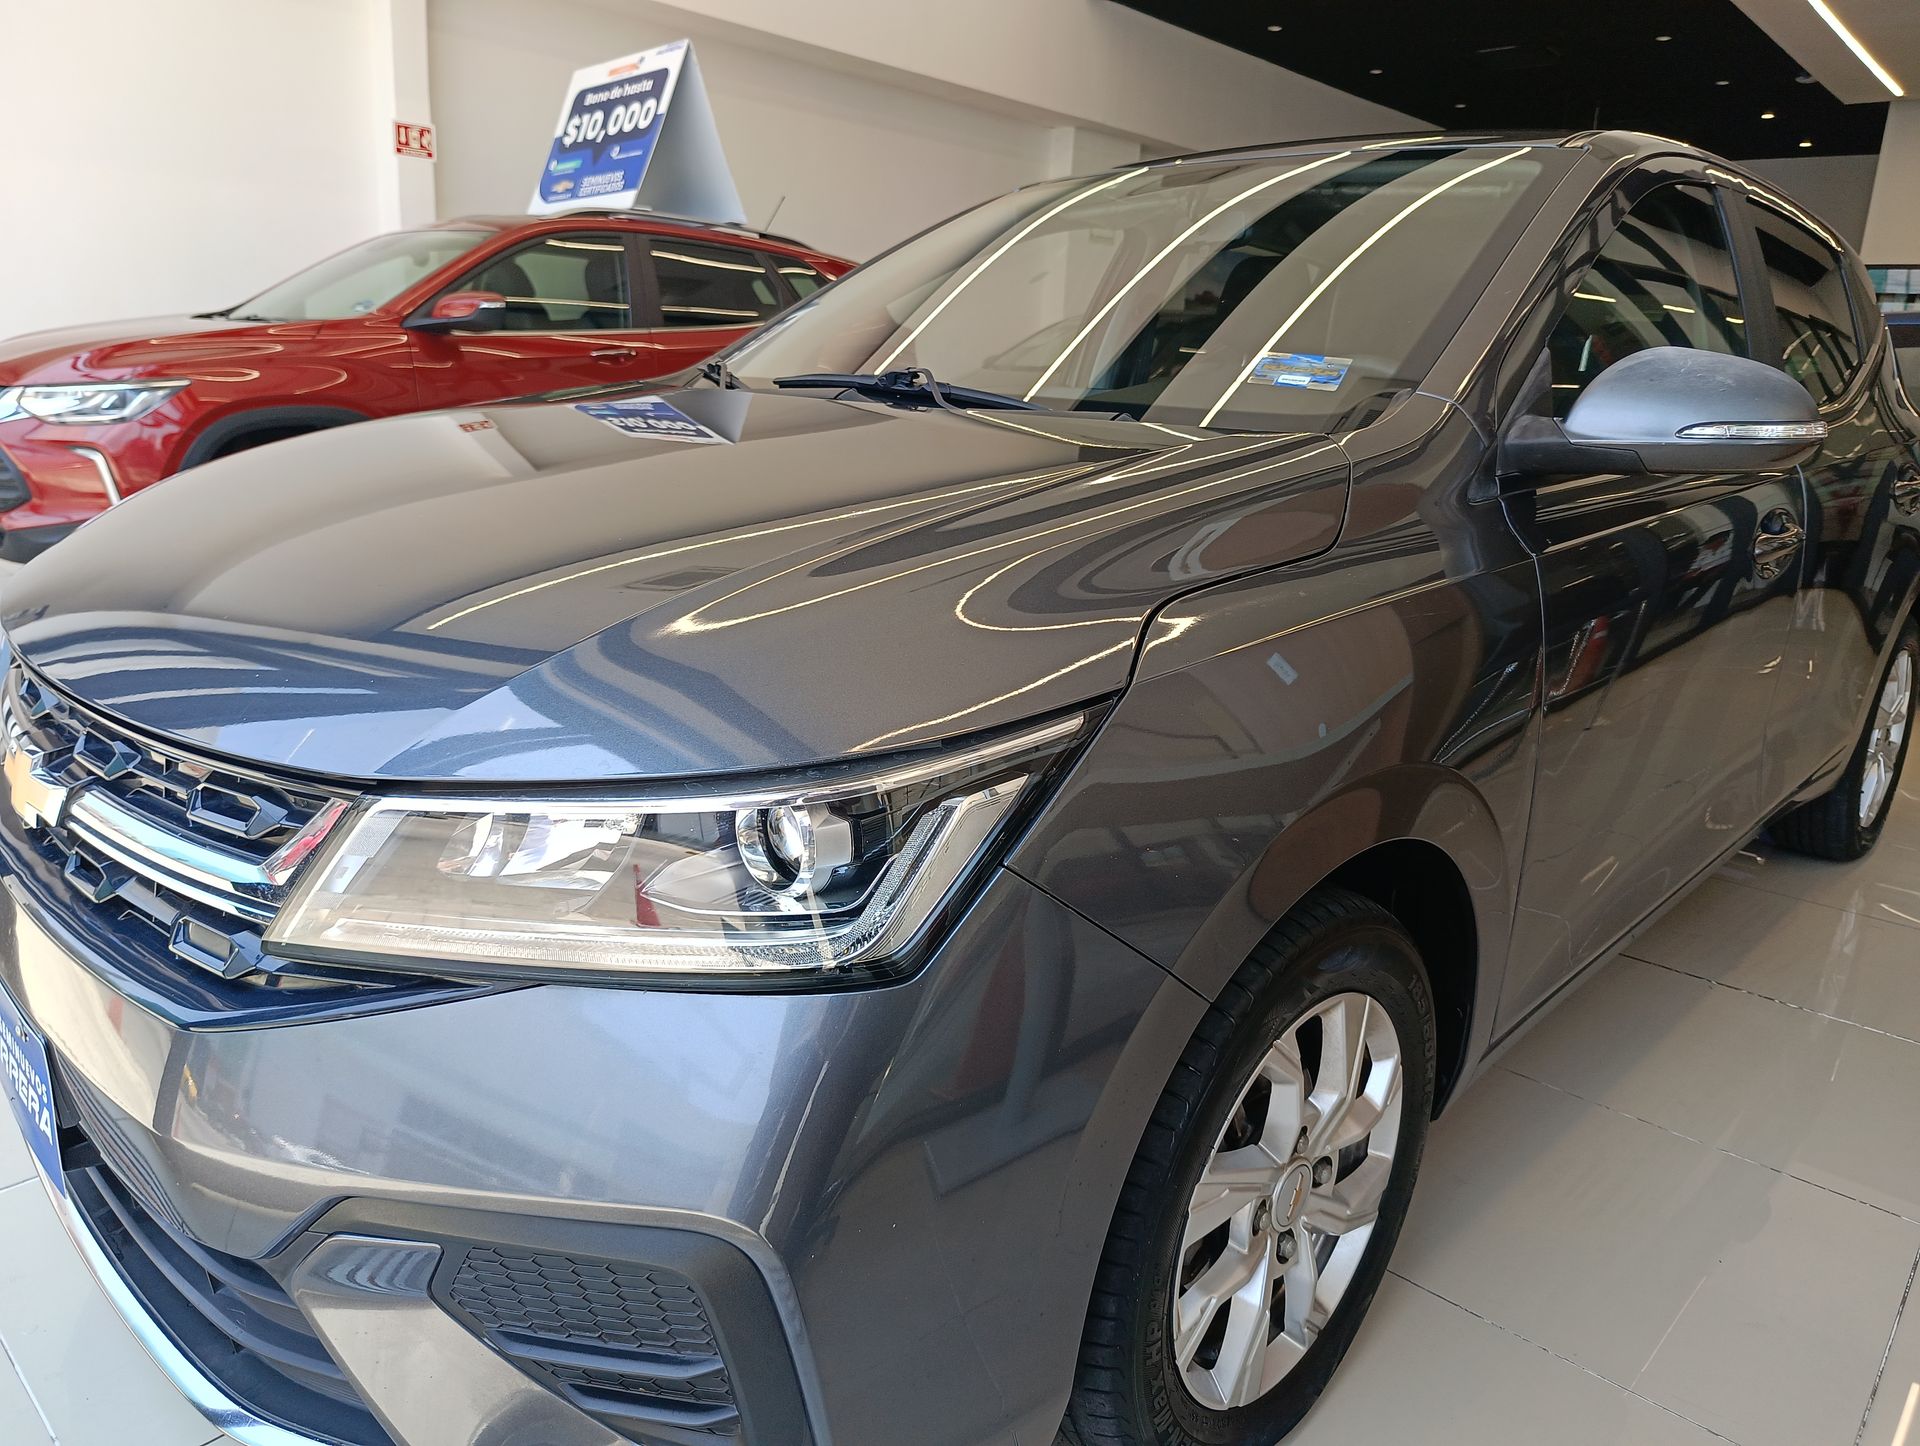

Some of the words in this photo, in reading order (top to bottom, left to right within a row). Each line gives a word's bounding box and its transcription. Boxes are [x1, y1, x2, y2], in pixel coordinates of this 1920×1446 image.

[584, 90, 609, 106] Bono
[610, 85, 623, 99] de
[623, 78, 654, 97] hasta
[562, 98, 658, 148] $10,000
